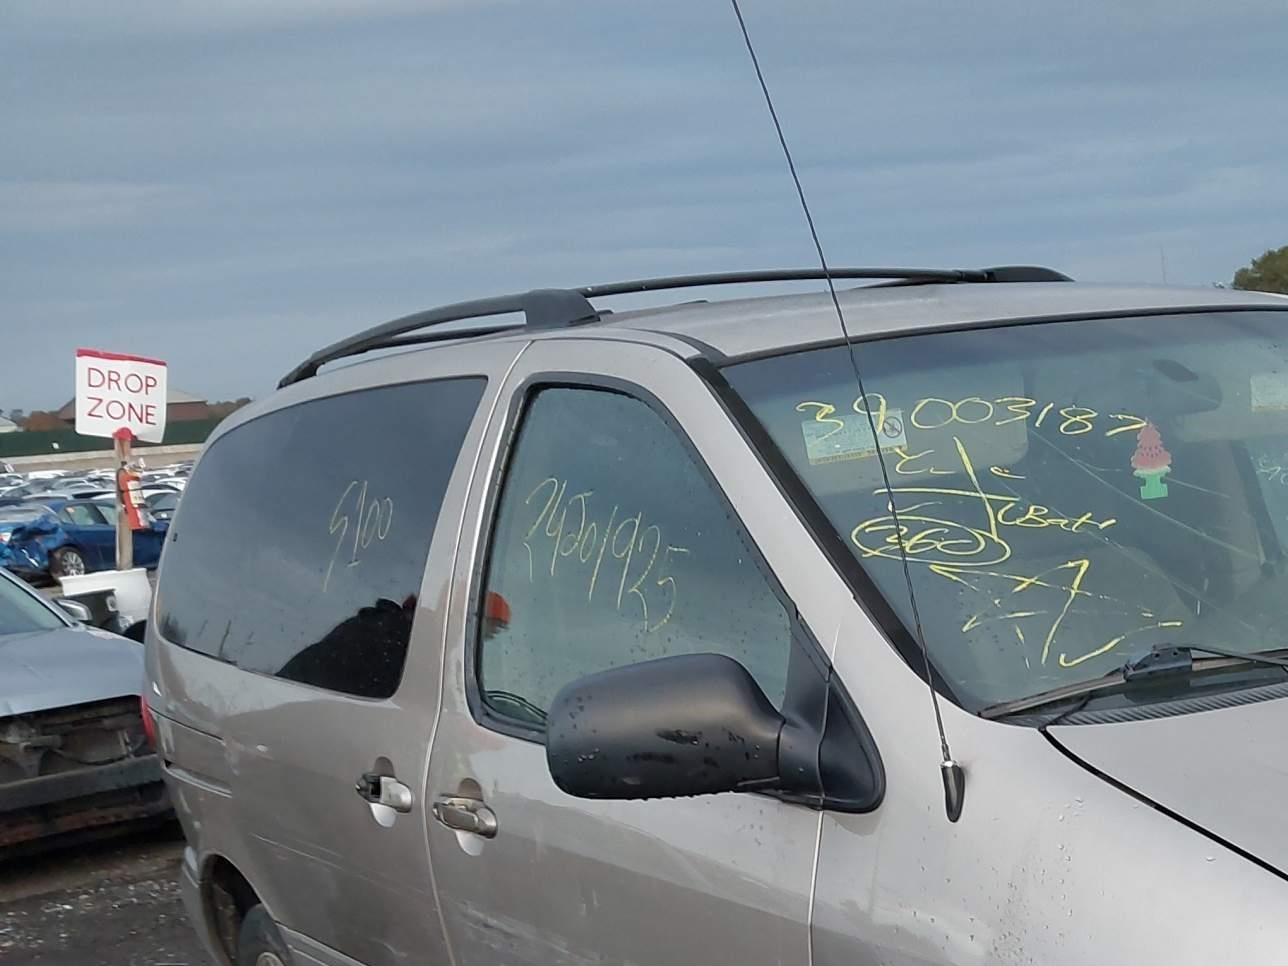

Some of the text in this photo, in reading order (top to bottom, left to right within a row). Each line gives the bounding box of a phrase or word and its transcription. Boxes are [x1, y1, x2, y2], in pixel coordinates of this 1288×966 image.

[87, 367, 158, 396] DROP
[86, 396, 157, 426] ZONE
[796, 393, 1150, 438] 39003187
